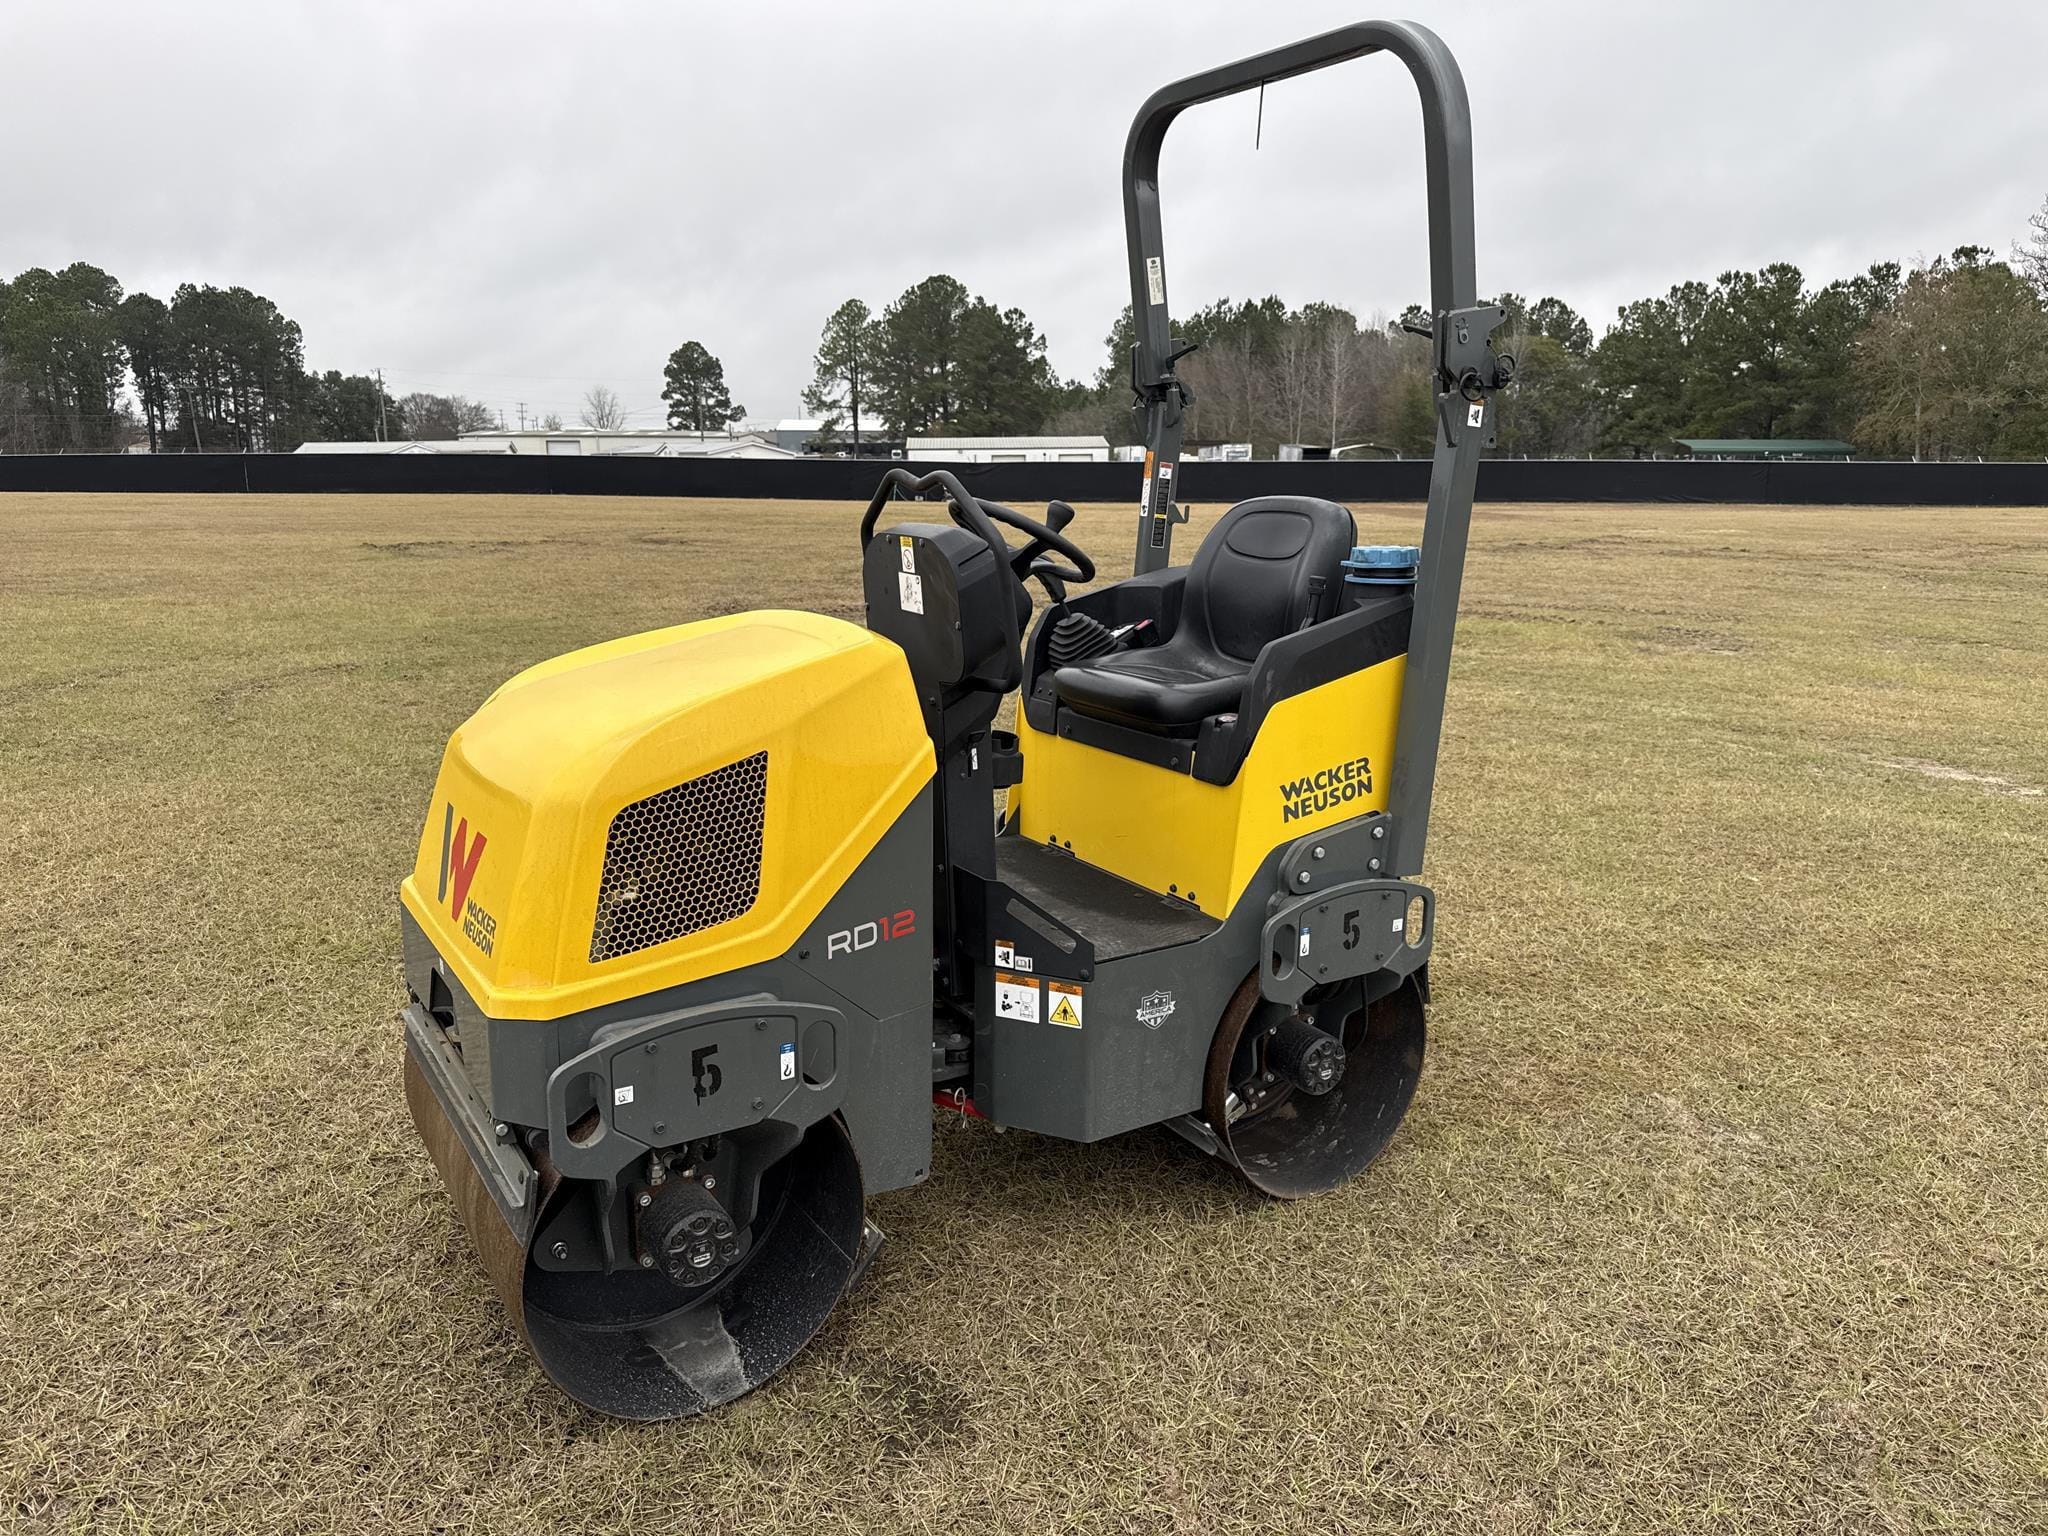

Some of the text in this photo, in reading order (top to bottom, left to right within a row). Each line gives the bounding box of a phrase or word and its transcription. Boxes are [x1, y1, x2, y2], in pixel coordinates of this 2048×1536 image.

[1280, 757, 1371, 801] WACKER
[1283, 776, 1372, 823] NEUSON
[462, 916, 494, 958] NEUSON
[468, 897, 497, 939] WACKER
[828, 908, 915, 960] RD12
[1343, 909, 1360, 950] 5
[1141, 1005, 1172, 1017] AMERICA
[691, 1044, 722, 1100] 5
